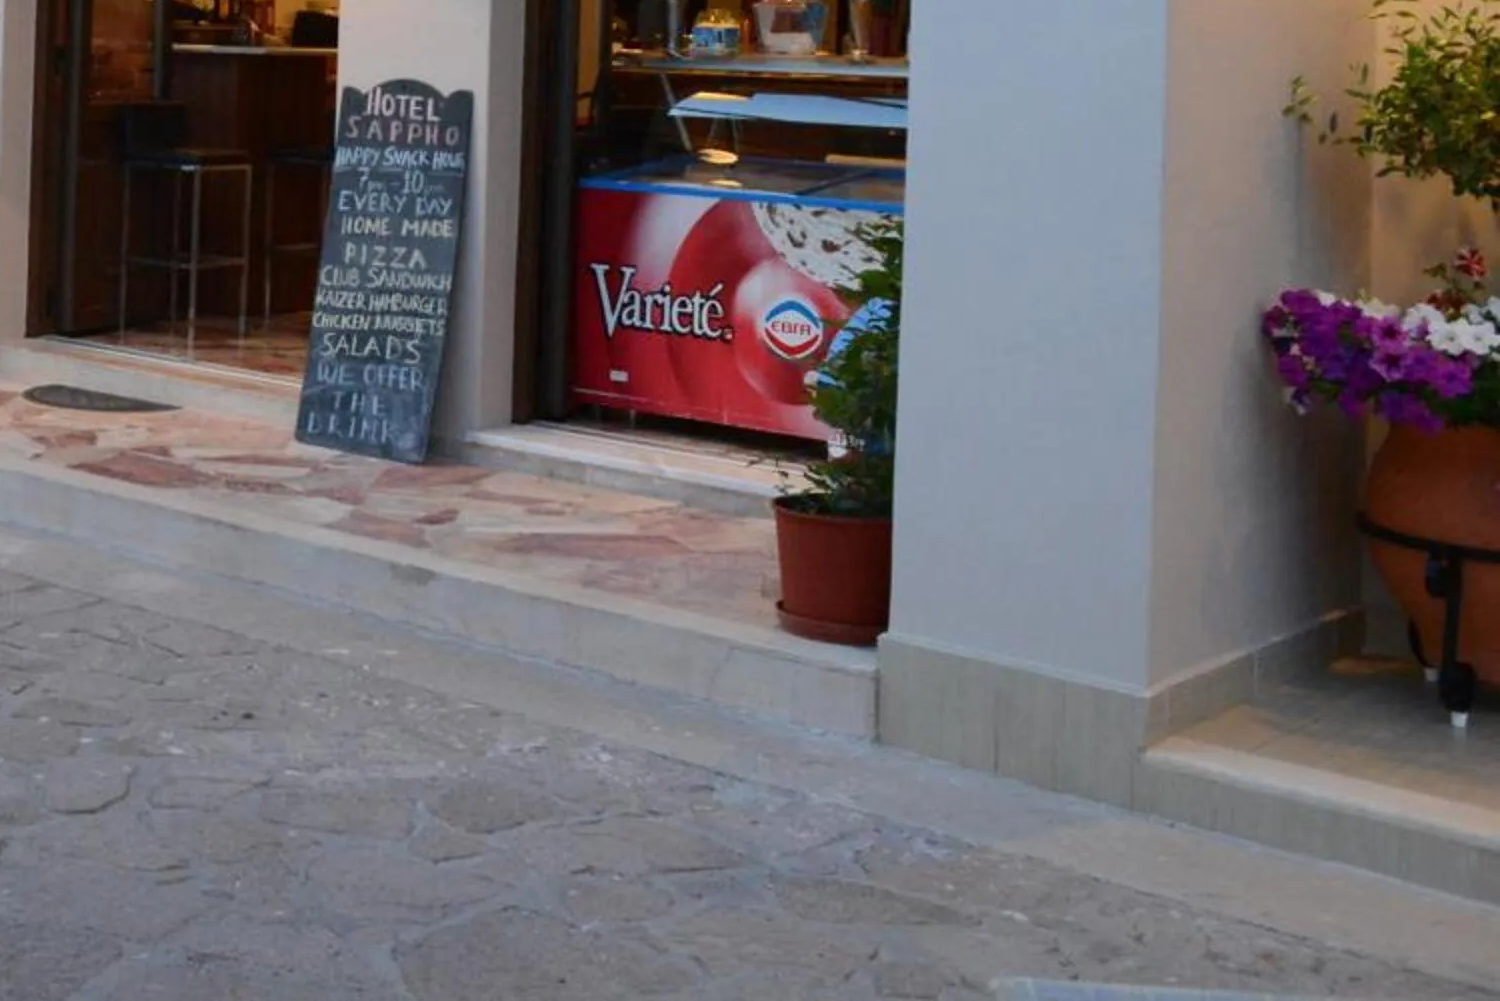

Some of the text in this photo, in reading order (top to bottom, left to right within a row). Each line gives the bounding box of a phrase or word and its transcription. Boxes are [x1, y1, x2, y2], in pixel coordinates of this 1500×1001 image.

[363, 86, 441, 122] HOTEL
[345, 116, 460, 146] SAPPHO
[338, 189, 453, 216] EVERY DAY
[341, 215, 453, 238] HOME MADE
[344, 241, 428, 271] PIZZA
[320, 264, 360, 287] CLUB
[320, 332, 421, 364] SALADS
[317, 359, 425, 392] WE OFFER
[332, 391, 387, 417] THE
